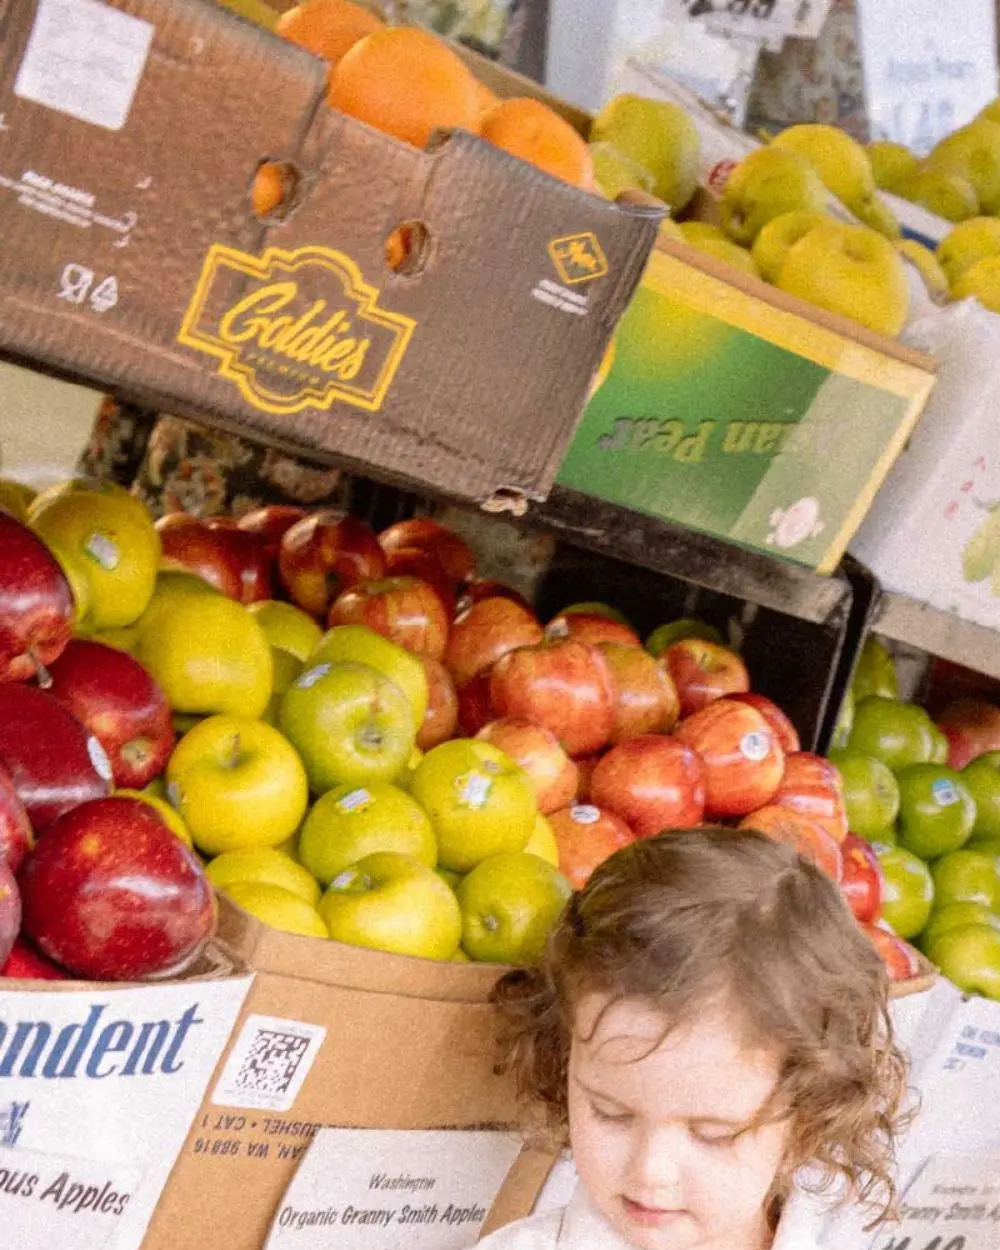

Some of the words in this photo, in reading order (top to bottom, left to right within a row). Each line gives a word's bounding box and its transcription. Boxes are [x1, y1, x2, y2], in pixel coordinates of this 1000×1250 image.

[219, 281, 371, 380] Goldies
[598, 416, 718, 463] Pear
[0, 1003, 204, 1079] ndent
[214, 1114, 247, 1133] CAT
[193, 1138, 241, 1157] 98816
[247, 1141, 270, 1159] WA
[40, 1172, 131, 1216] Apples
[369, 1174, 436, 1194] Washington
[279, 1206, 338, 1230] Organic
[341, 1206, 400, 1228] Granny
[398, 1205, 438, 1224] Smith
[442, 1204, 487, 1224] Apples
